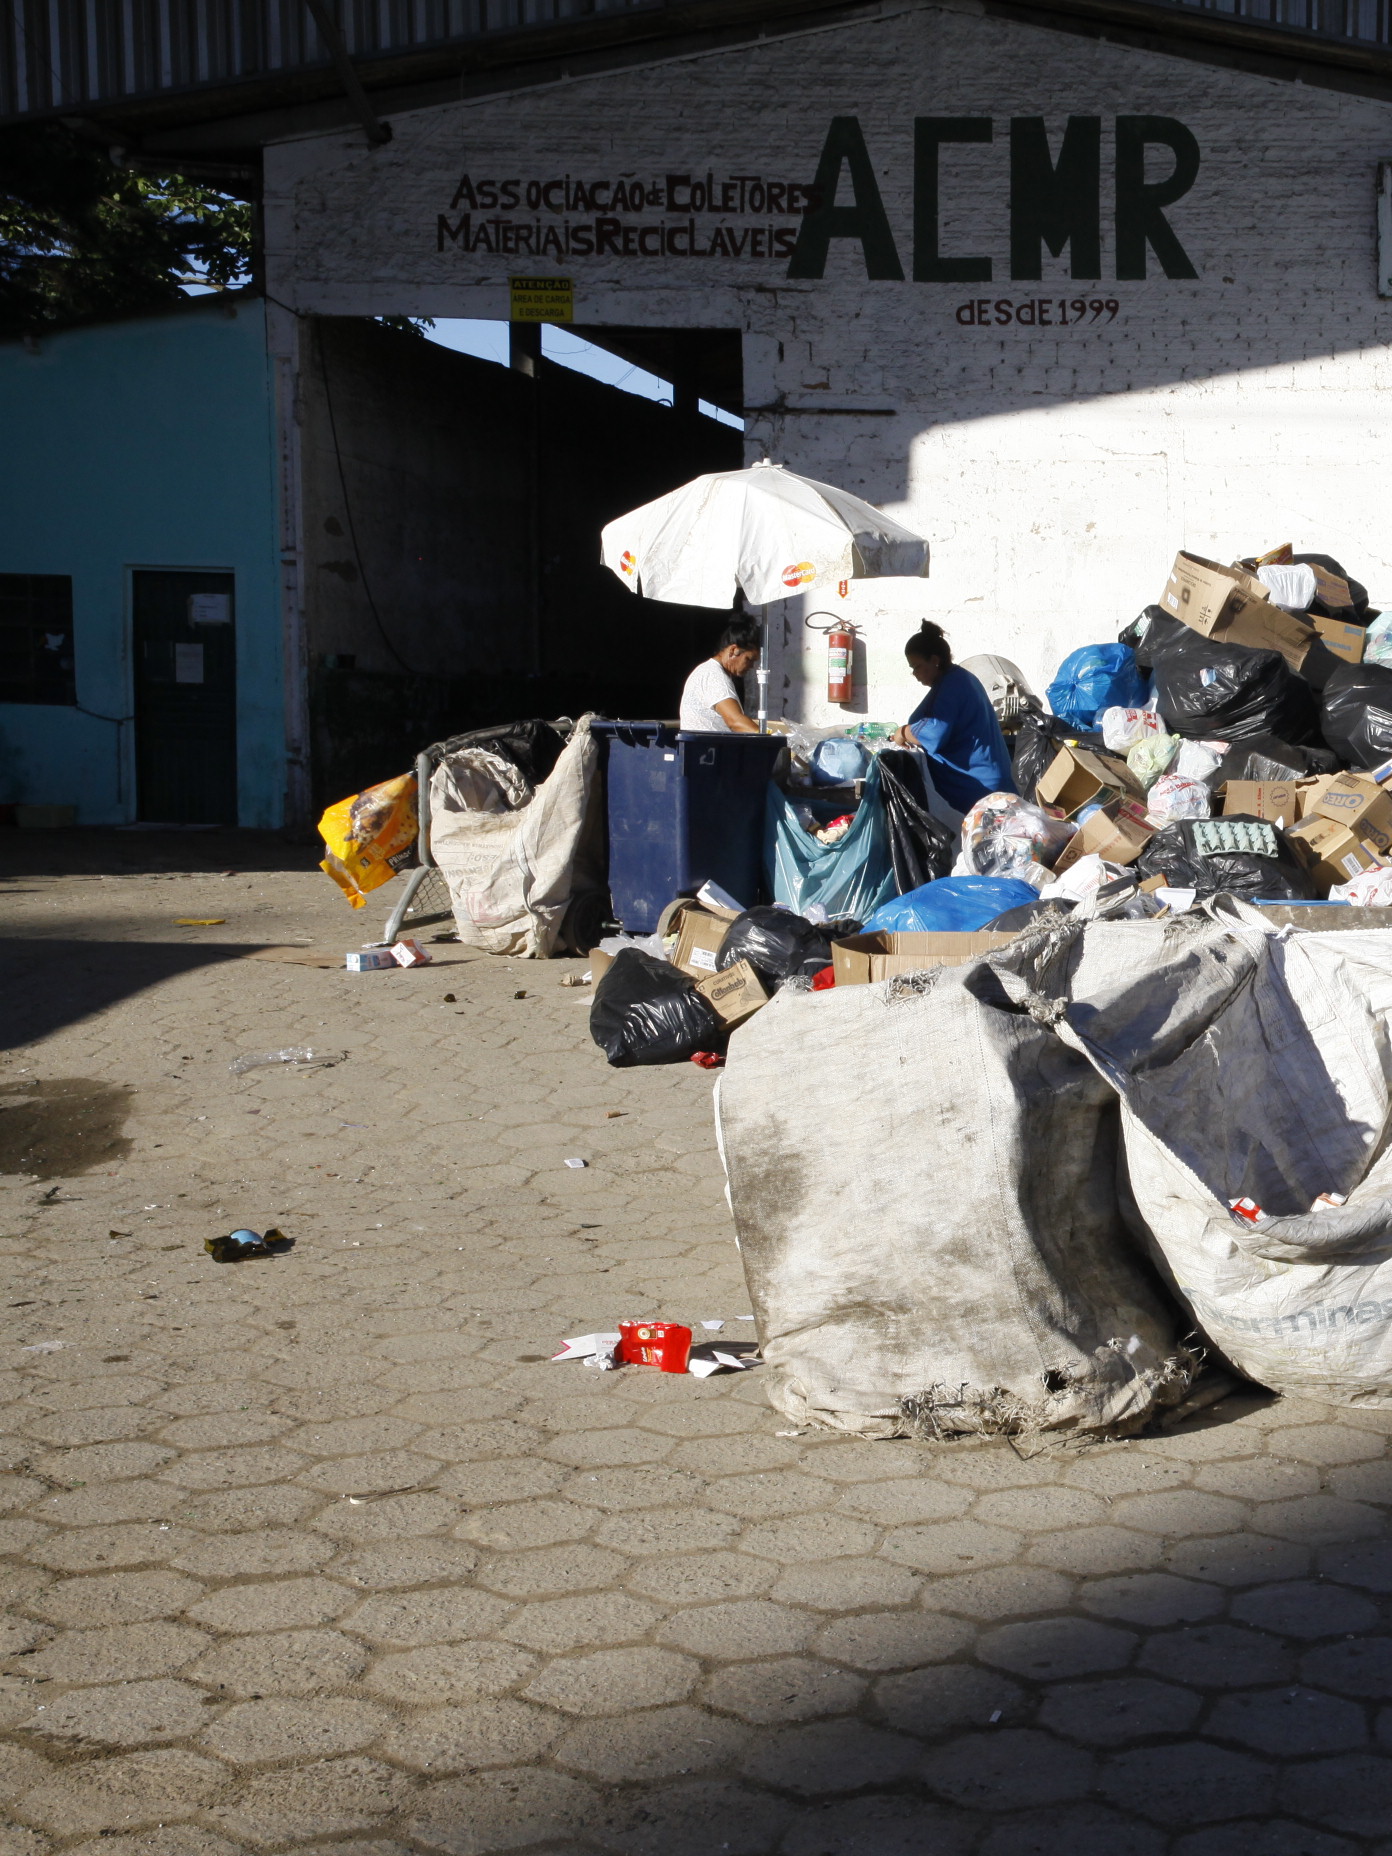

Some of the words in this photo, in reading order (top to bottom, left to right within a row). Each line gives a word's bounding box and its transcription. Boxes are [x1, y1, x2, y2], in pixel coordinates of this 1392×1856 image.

[787, 114, 1200, 283] ACMR
[513, 279, 569, 290] ATENÇÃO
[533, 295, 543, 303] DE
[545, 295, 570, 304] CARGA
[525, 308, 564, 317] DESCARGA
[1323, 793, 1364, 809] OREO
